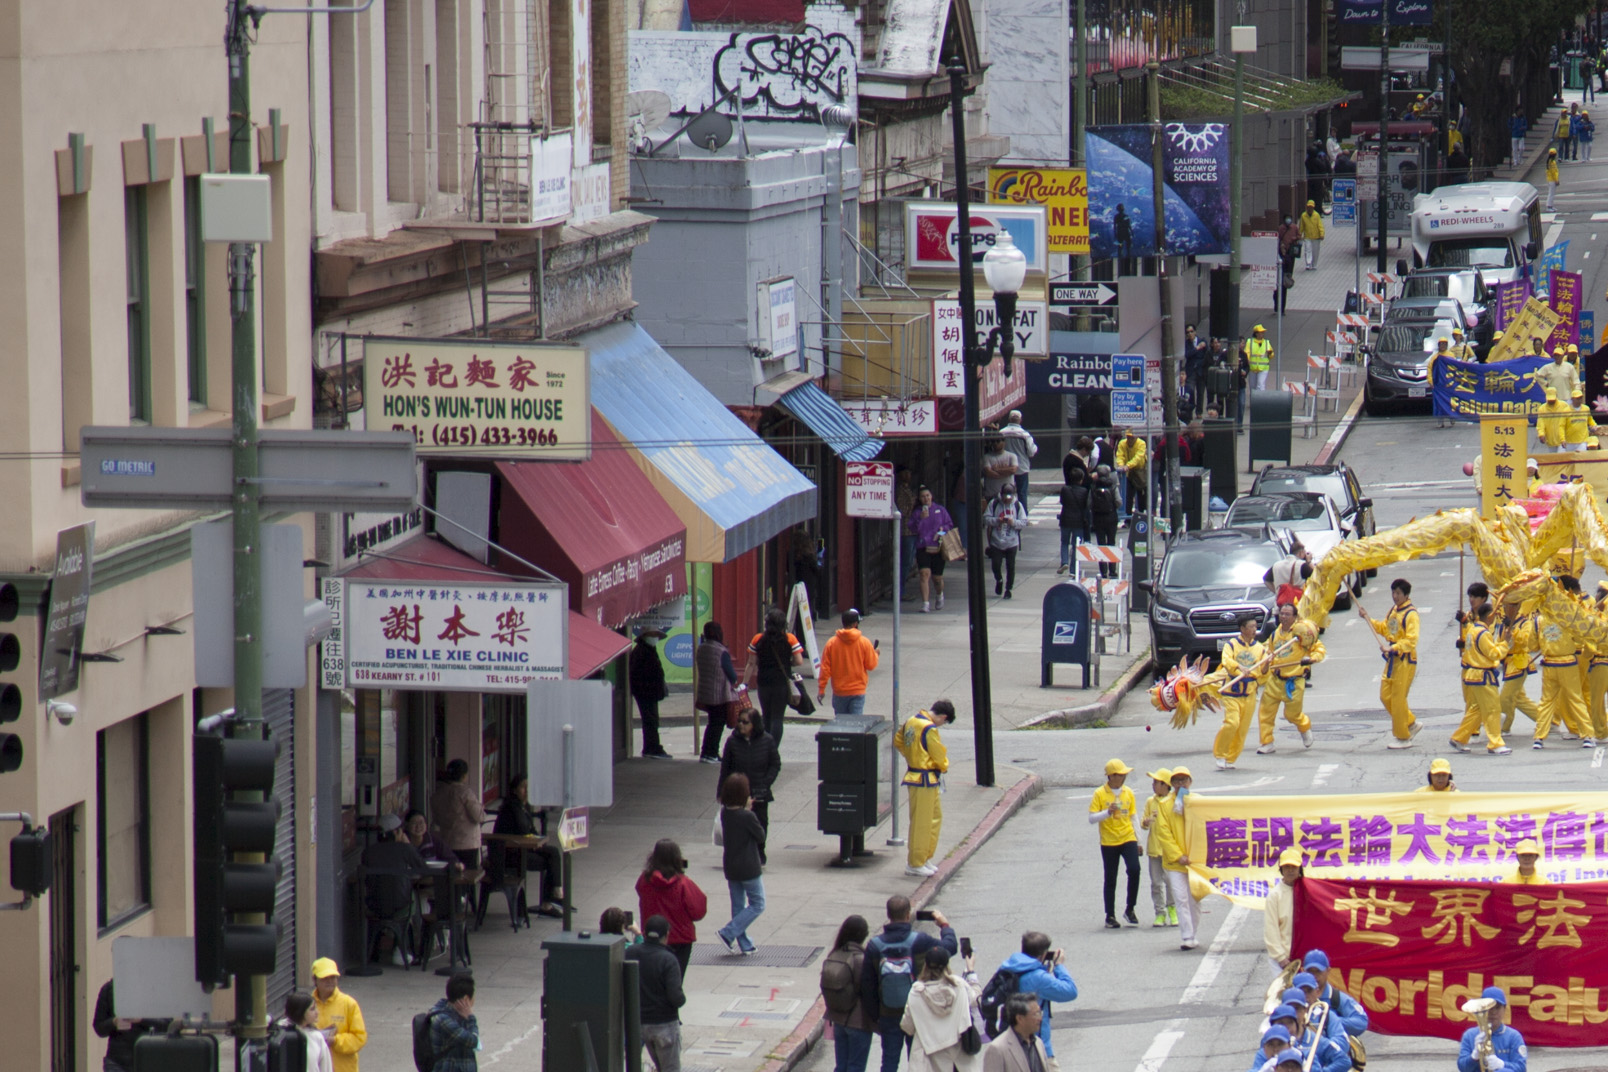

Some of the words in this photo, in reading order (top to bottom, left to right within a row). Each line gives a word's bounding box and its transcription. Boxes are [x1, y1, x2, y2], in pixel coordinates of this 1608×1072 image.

[1344, 9, 1369, 19] Down
[1371, 9, 1379, 17] to
[1396, 1, 1427, 14] Explore
[1173, 157, 1217, 165] CALIFORNIA
[1173, 173, 1218, 182] SCIENCES
[1441, 216, 1493, 226] REDI-WHEELS
[1056, 290, 1075, 299] ONE
[1079, 290, 1098, 299] WAY
[1013, 310, 1037, 327] FAT
[1114, 358, 1126, 366] Pay
[382, 353, 539, 392] 洪記麵家
[546, 371, 565, 379] Since
[1049, 375, 1112, 388] CLEAN
[1114, 393, 1126, 401] Pay
[1127, 392, 1134, 401] by
[384, 395, 430, 417] HON'S
[435, 396, 506, 420] WUN-TUN
[511, 398, 562, 421] HOUSE
[1451, 397, 1498, 415] Falun
[432, 423, 477, 446] (415)
[481, 426, 558, 447] 433-3966
[1494, 426, 1515, 436] 5.13
[102, 459, 115, 472] GO
[117, 460, 154, 473] METRIC
[848, 477, 862, 485] NO
[863, 477, 890, 486] STOPPING
[852, 490, 867, 500] ANY
[870, 491, 887, 501] TIME
[56, 545, 83, 577] Available
[587, 575, 598, 597] Latte
[613, 562, 625, 586] Coffee
[380, 604, 531, 648] 謝本樂
[386, 648, 417, 660] BEN
[422, 649, 441, 661] LE
[446, 650, 472, 661] XIE
[477, 651, 529, 663] CLINIC
[355, 669, 370, 680] 638
[371, 672, 403, 681] KEARNY
[405, 672, 418, 681] ST.
[426, 672, 441, 682] 101
[486, 674, 503, 683] TEL:
